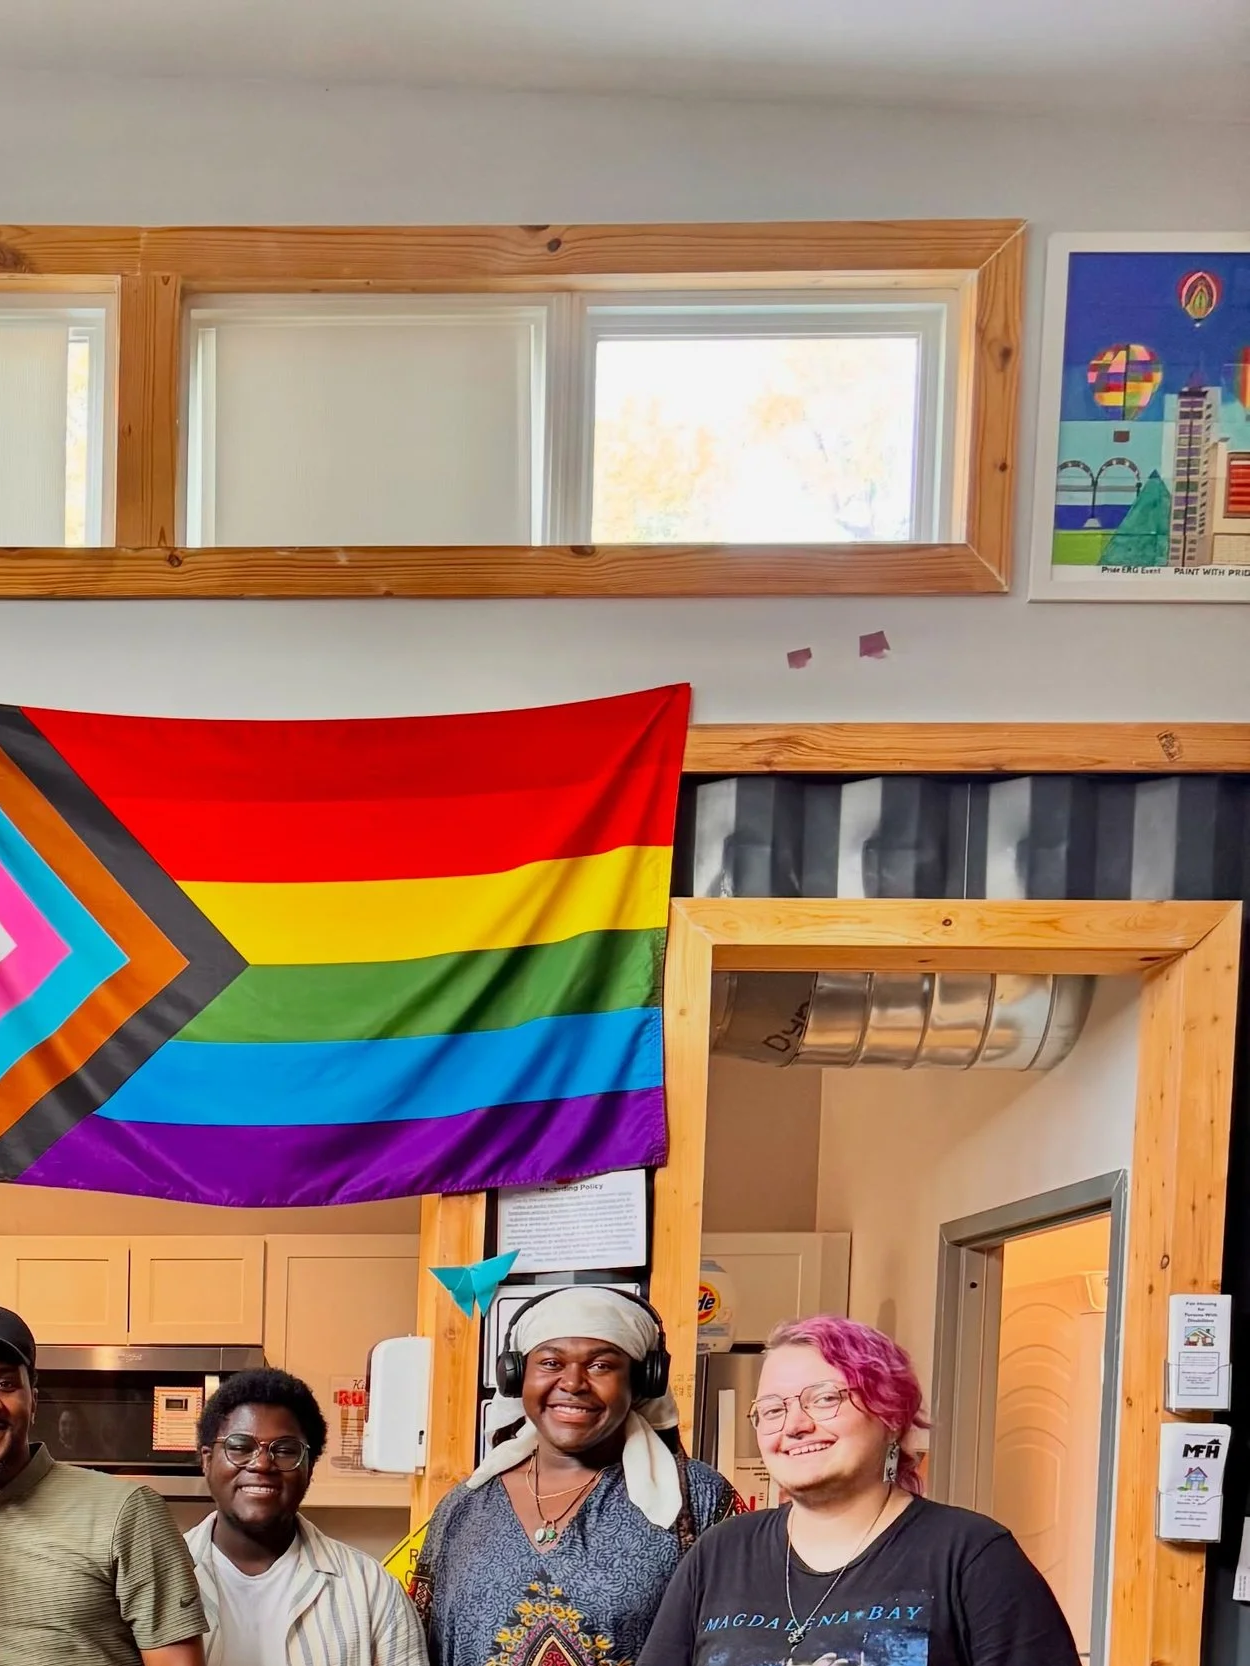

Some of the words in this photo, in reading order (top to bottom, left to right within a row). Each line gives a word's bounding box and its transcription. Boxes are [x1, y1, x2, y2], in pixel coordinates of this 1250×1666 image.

[1174, 567, 1200, 576] PAINT
[1202, 568, 1225, 577] WITH
[580, 1183, 604, 1191] Policy
[698, 1291, 716, 1311] de
[1182, 1443, 1220, 1459] MFH
[704, 1610, 850, 1633] MAGDALENA
[867, 1606, 923, 1621] BAY
